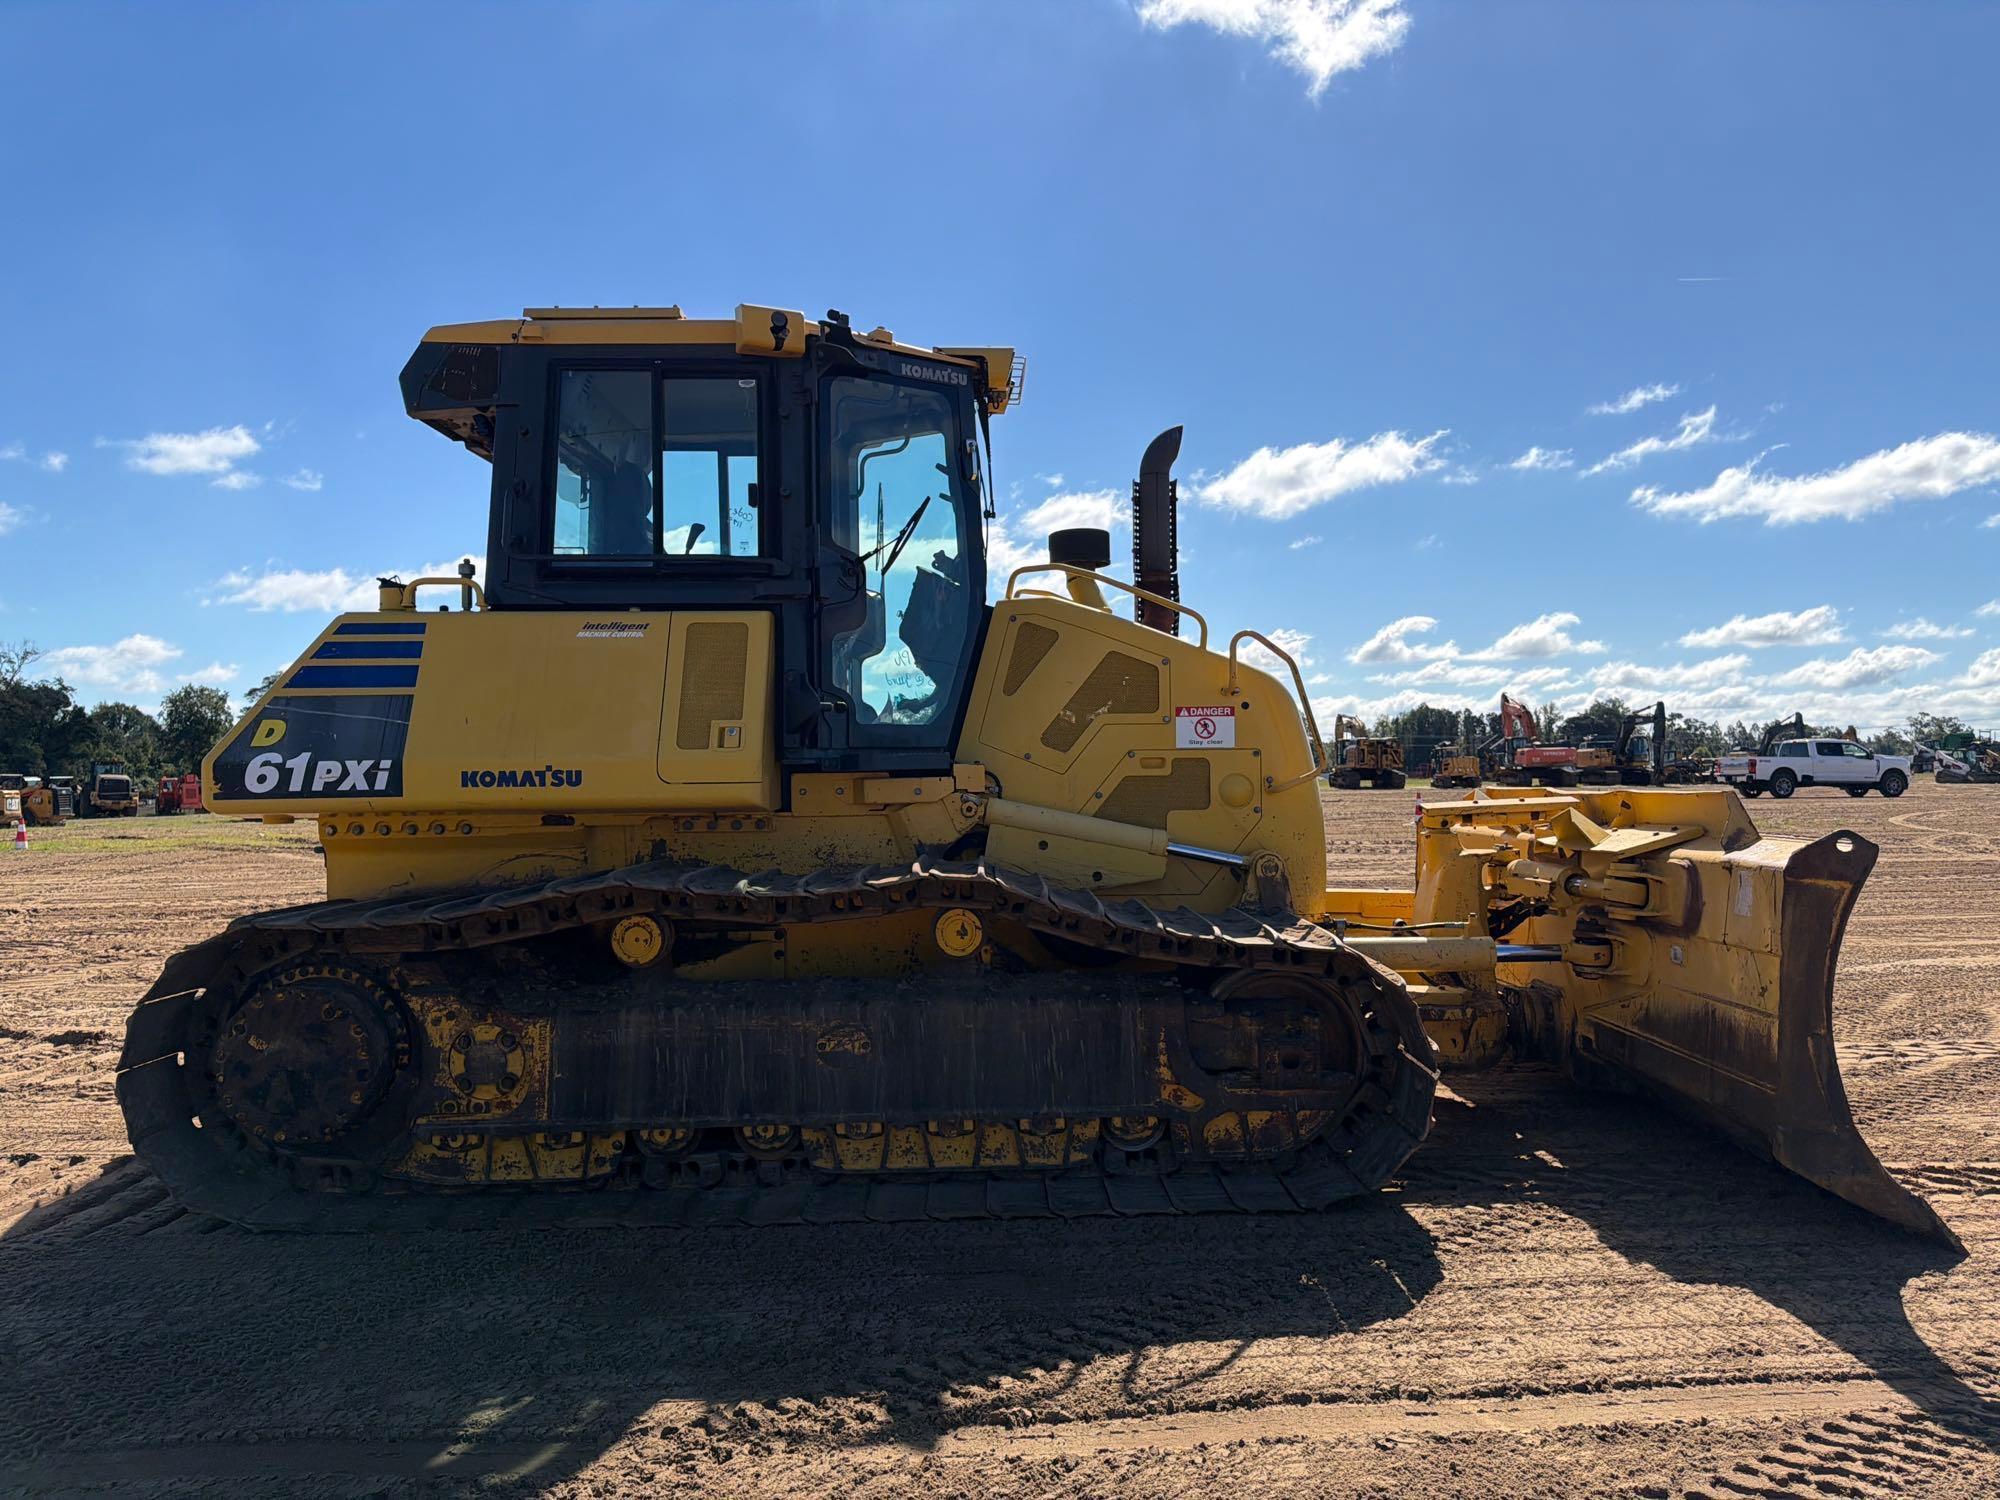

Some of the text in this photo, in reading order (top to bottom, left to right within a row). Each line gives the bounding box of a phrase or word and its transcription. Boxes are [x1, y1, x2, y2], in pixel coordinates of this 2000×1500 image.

[901, 363, 968, 386] KOMATSU
[582, 621, 651, 632] intelligent
[1190, 707, 1231, 716] DANGER
[250, 719, 287, 747] D
[461, 765, 582, 788] KOMATSU
